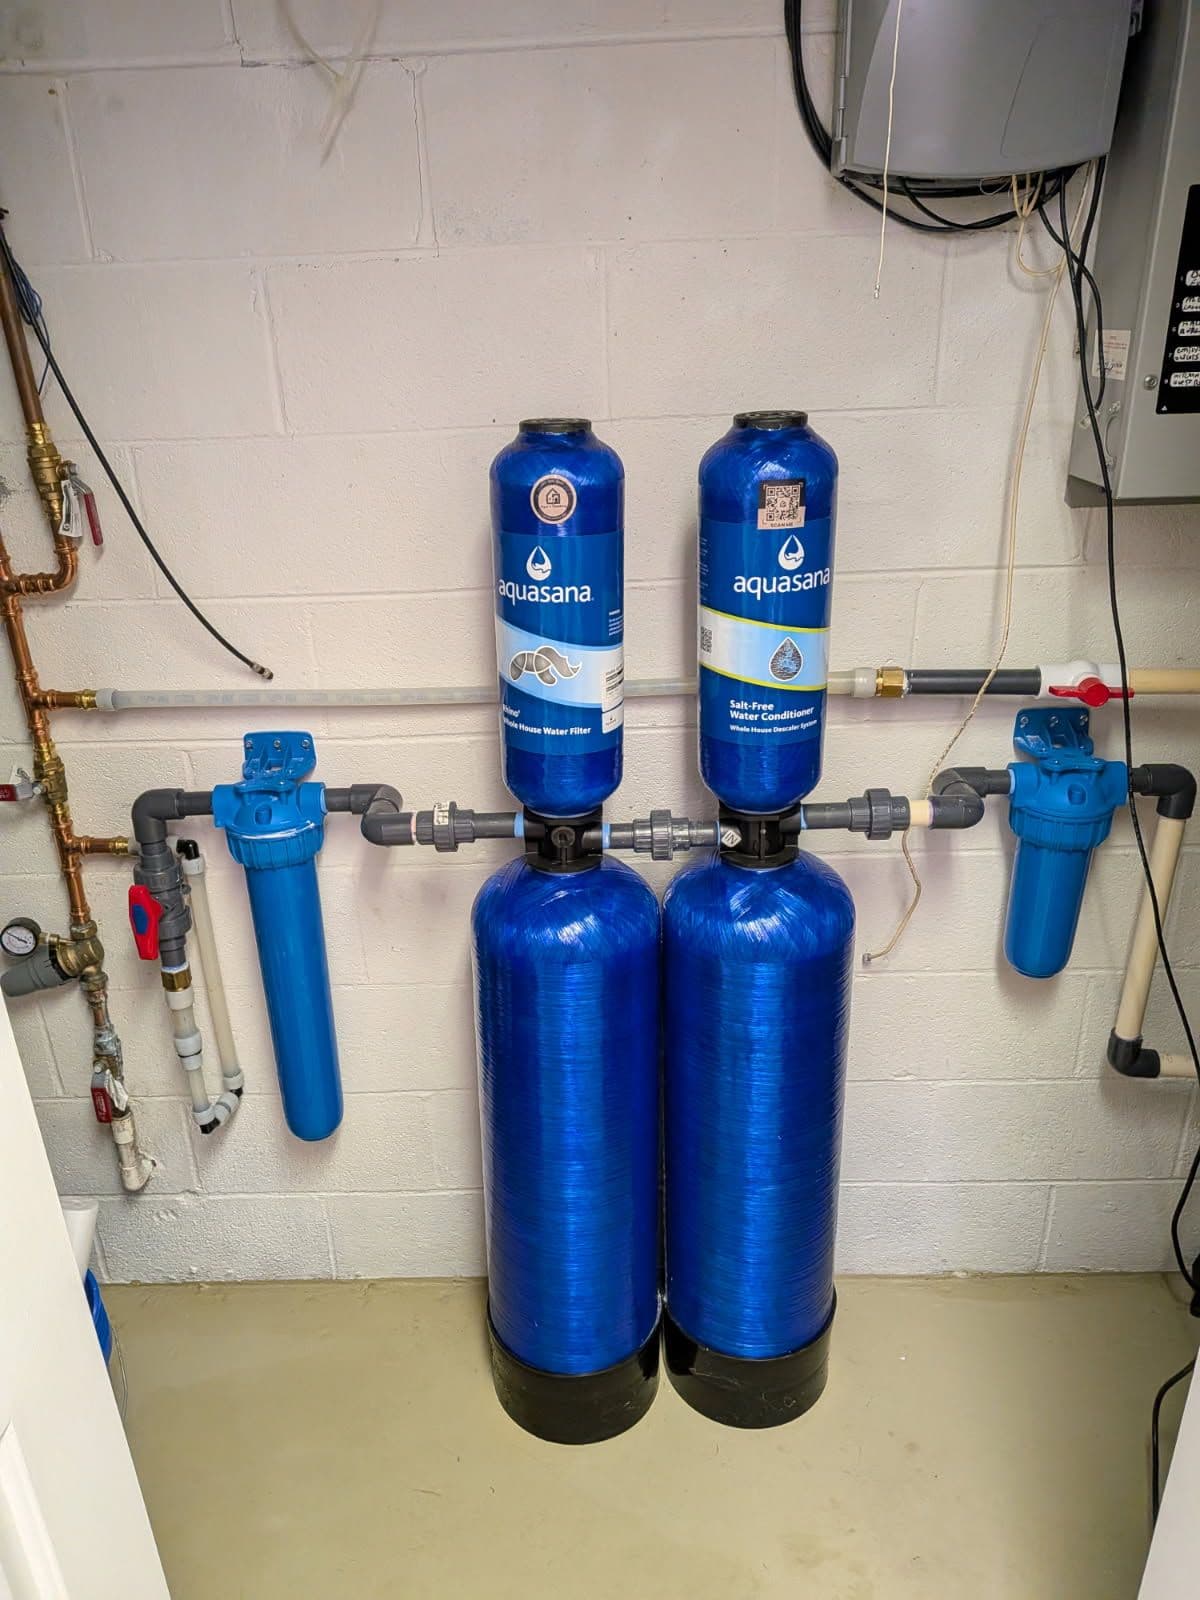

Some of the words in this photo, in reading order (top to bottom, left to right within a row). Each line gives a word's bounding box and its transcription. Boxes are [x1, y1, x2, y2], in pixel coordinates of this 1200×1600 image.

[733, 567, 831, 601] aquasana
[498, 579, 594, 607] aquasana
[729, 699, 775, 711] Salt-Free
[729, 709, 759, 721] Water
[761, 706, 815, 721] Conditioner
[519, 723, 542, 734] House
[542, 726, 568, 736] Water
[569, 726, 592, 736] Filter
[729, 724, 750, 733] Whole
[751, 726, 772, 734] House
[773, 723, 800, 733] Descaler
